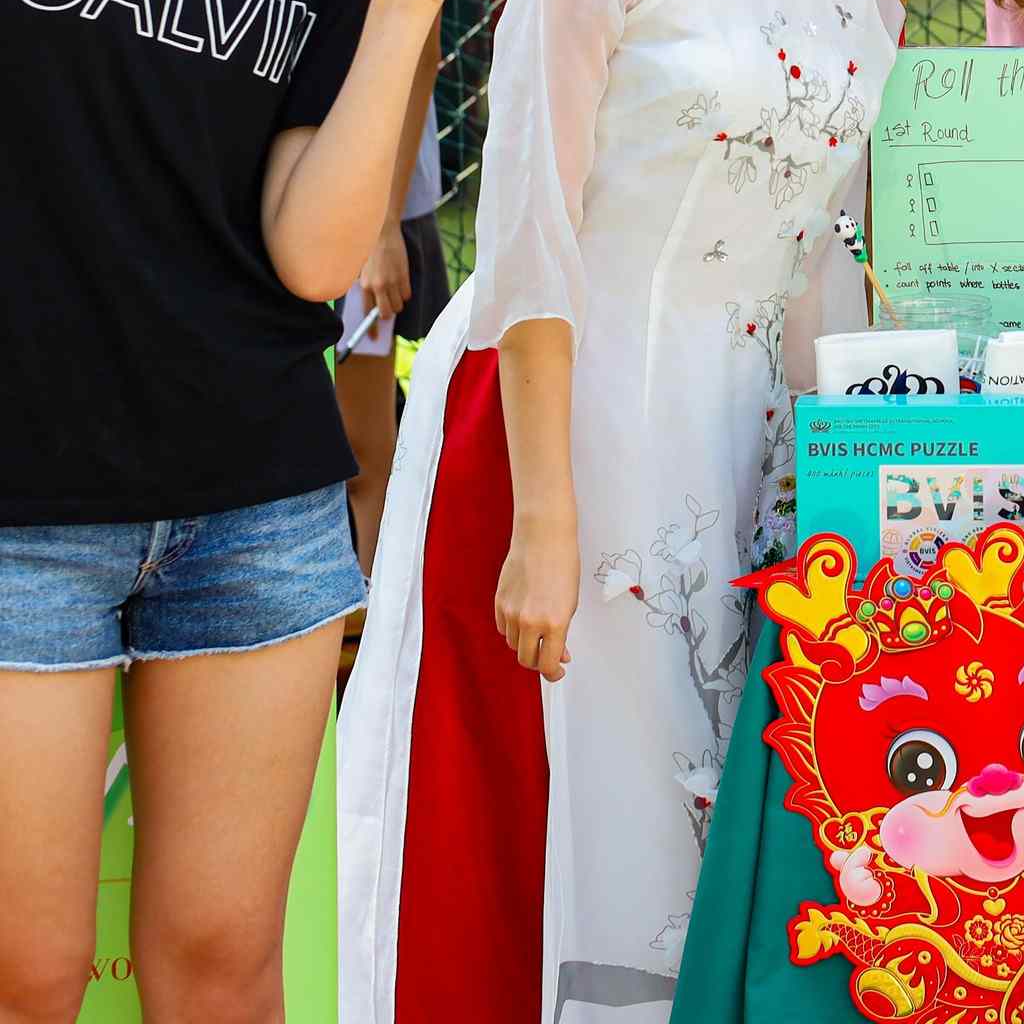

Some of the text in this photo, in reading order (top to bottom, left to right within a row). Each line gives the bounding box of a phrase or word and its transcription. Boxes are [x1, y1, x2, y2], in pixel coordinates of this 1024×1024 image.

[912, 58, 974, 109] Roll
[881, 119, 974, 143] 1st Round
[937, 262, 961, 273] table
[896, 280, 919, 288] count
[926, 280, 952, 296] points
[959, 279, 985, 289] where
[808, 442, 979, 457] BVIS HCMC PUZZLE
